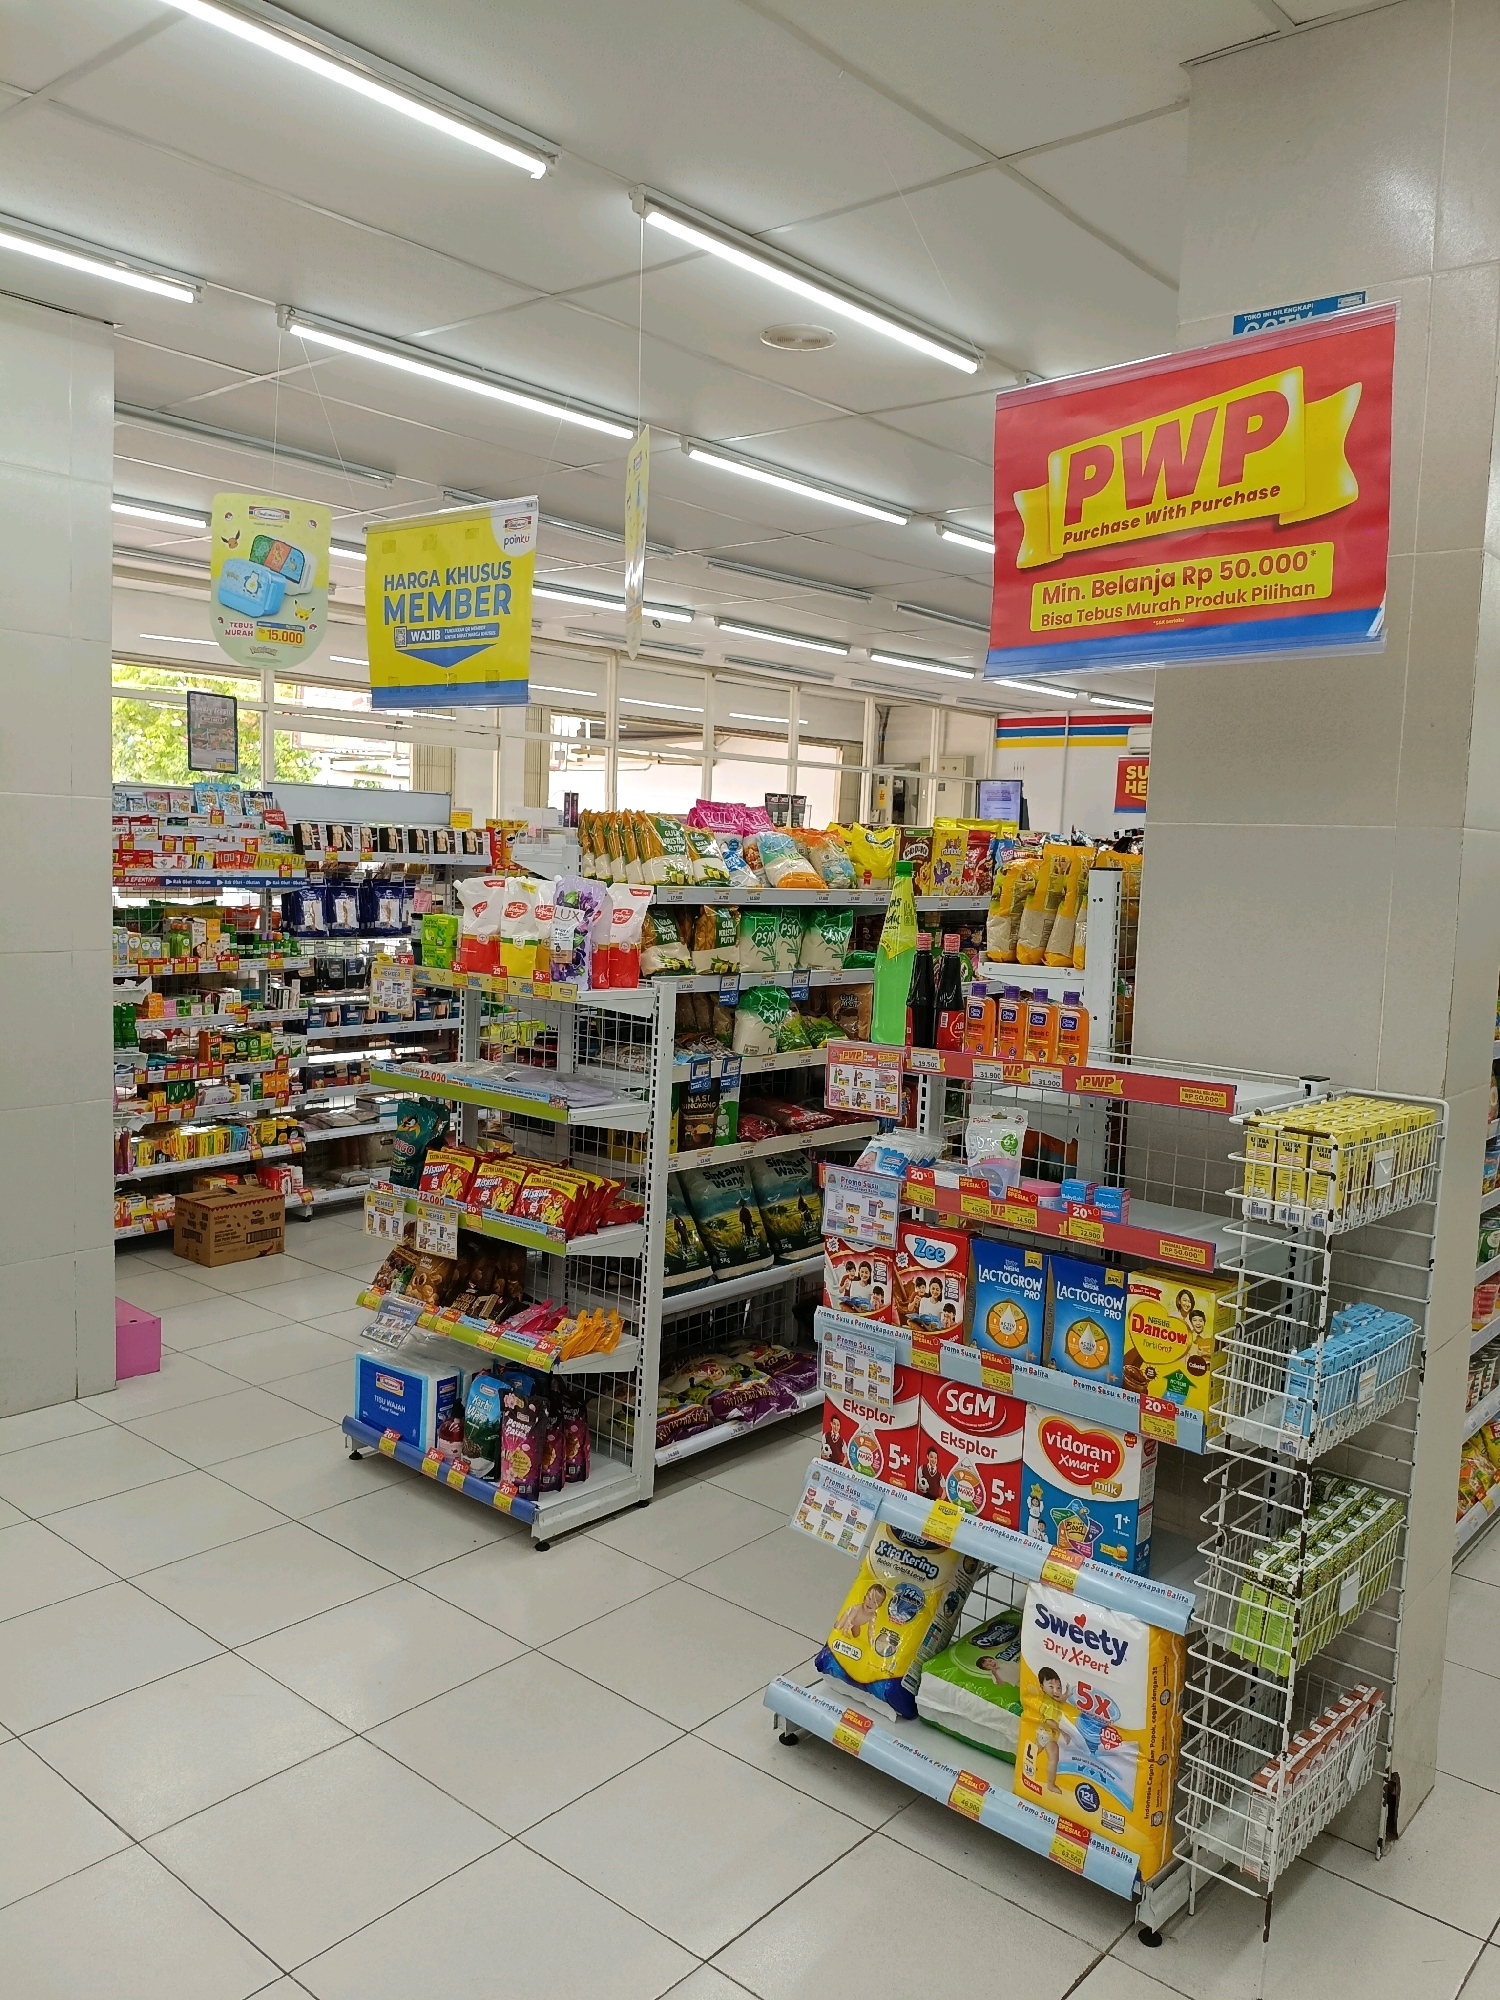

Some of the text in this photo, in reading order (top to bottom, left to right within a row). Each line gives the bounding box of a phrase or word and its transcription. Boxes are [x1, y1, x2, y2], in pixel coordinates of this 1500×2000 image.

[1244, 312, 1261, 322] TOKO
[1272, 303, 1314, 316] DILENGKAPI
[1064, 390, 1290, 527] PWP
[1062, 484, 1281, 545] Purchase With Purchase
[504, 532, 530, 549] poinku
[384, 560, 512, 592] HARGA KHUSUS
[1042, 584, 1086, 605] Min.
[1092, 568, 1176, 598] Belanja
[1182, 566, 1212, 590] Rp
[384, 583, 512, 626] MEMBER
[1042, 582, 1316, 627] Bisa Tebus Murah Produk Pilihan
[266, 629, 303, 644] 15.000
[410, 630, 441, 642] WAJIB
[554, 907, 581, 923] LUX
[721, 920, 734, 928] GULA
[755, 932, 775, 944] PSM
[782, 923, 799, 936] PSM
[1082, 1076, 1114, 1088] PWP
[688, 1094, 710, 1103] NASI
[1003, 1134, 1016, 1146] 6+
[422, 1164, 450, 1176] BISKUAT
[474, 1178, 502, 1188] BISKUAT
[840, 1176, 861, 1187] Promo
[862, 1181, 879, 1190] Susu
[419, 1192, 445, 1206] 12.000
[522, 1188, 550, 1198] BISKUAT
[914, 1238, 946, 1263] Zee
[978, 1264, 1043, 1292] LACTOGROW
[1024, 1290, 1040, 1300] PRO
[1056, 1280, 1124, 1311] LACTOGROW
[817, 1309, 836, 1320] Promo
[836, 1313, 850, 1324] Susu
[854, 1318, 894, 1336] Perlengkapan
[1104, 1309, 1122, 1320] PRO
[1131, 1313, 1188, 1345] Dancow
[836, 1334, 875, 1352] Promo Susu
[913, 1335, 933, 1346] SPESIAL
[940, 1342, 976, 1359] Promo Susu
[1028, 1366, 1050, 1380] Balita
[1072, 1379, 1096, 1392] Promo
[1098, 1385, 1115, 1398] Susu
[842, 1398, 896, 1426] Eksplor
[946, 1389, 997, 1419] SGM
[1153, 1426, 1174, 1437] 39.500
[940, 1431, 998, 1459] Eksplor
[1046, 1431, 1112, 1463] vidoran
[888, 1443, 911, 1470] 5+
[1058, 1454, 1100, 1473] Xmart
[824, 1476, 861, 1498] Promo Susu
[991, 1478, 1015, 1506] 5+
[1094, 1480, 1118, 1495] milk
[1114, 1513, 1130, 1530] 1+
[978, 1521, 1044, 1551] Perlengkapan Balita
[900, 1550, 938, 1579] Kering
[1050, 1550, 1074, 1563] SPESIAL
[1090, 1562, 1189, 1604] Susu Perlengkapan Balita
[1035, 1603, 1128, 1666] Sweety
[1044, 1637, 1068, 1661] Dry
[1068, 1646, 1110, 1675] X-Pert
[776, 1677, 808, 1696] Promo Susu
[1076, 1680, 1112, 1720] 5x
[844, 1714, 864, 1727] SPESIAL
[893, 1739, 928, 1762] Promo Susu
[1026, 1744, 1034, 1760] L
[958, 1776, 979, 1789] SPESIAL
[961, 1799, 980, 1813] 46.900
[1017, 1801, 1056, 1825] Promo Susu
[1058, 1823, 1082, 1837] SPESIAL
[1061, 1850, 1082, 1864] 63.500
[1110, 1846, 1134, 1864] Balita
